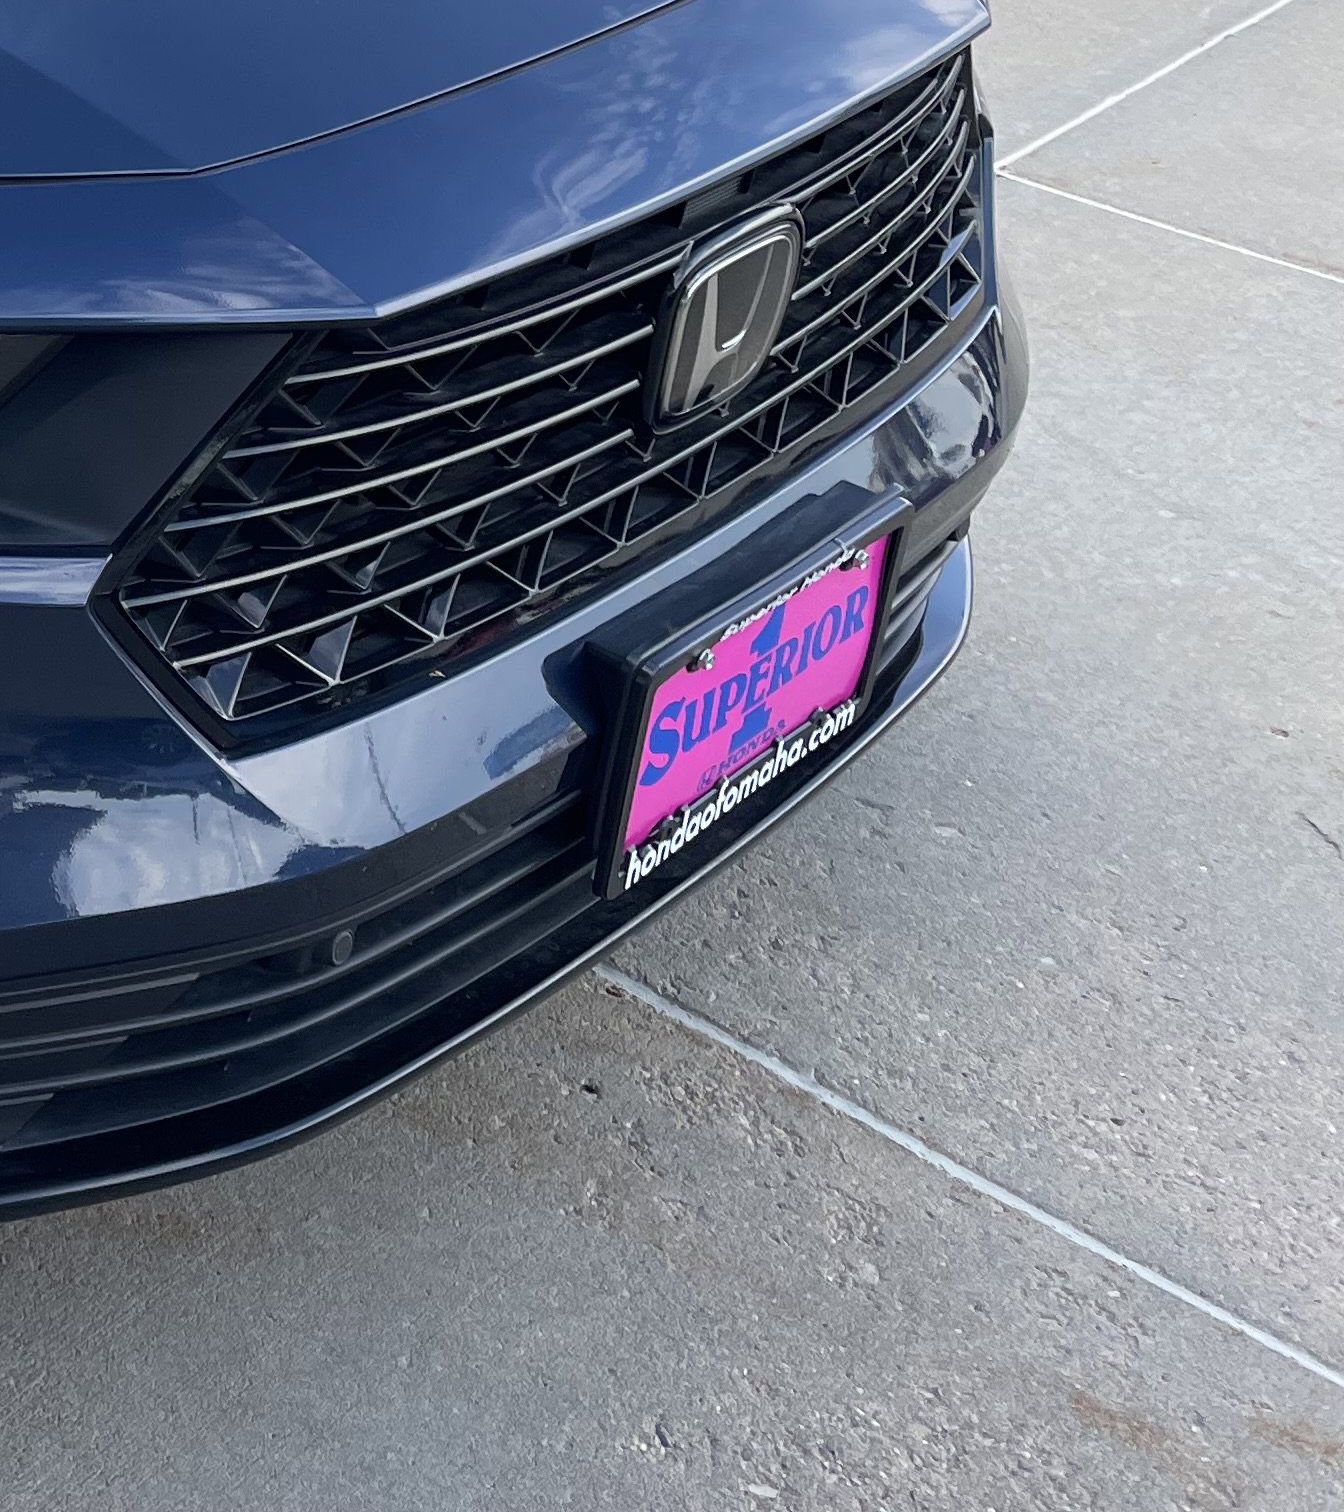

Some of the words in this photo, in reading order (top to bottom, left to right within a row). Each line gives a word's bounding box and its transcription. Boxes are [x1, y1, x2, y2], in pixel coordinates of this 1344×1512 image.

[639, 585, 869, 786] SUPERIOR
[716, 719, 786, 774] HONDA
[624, 701, 856, 891] hondaofomaha.com
